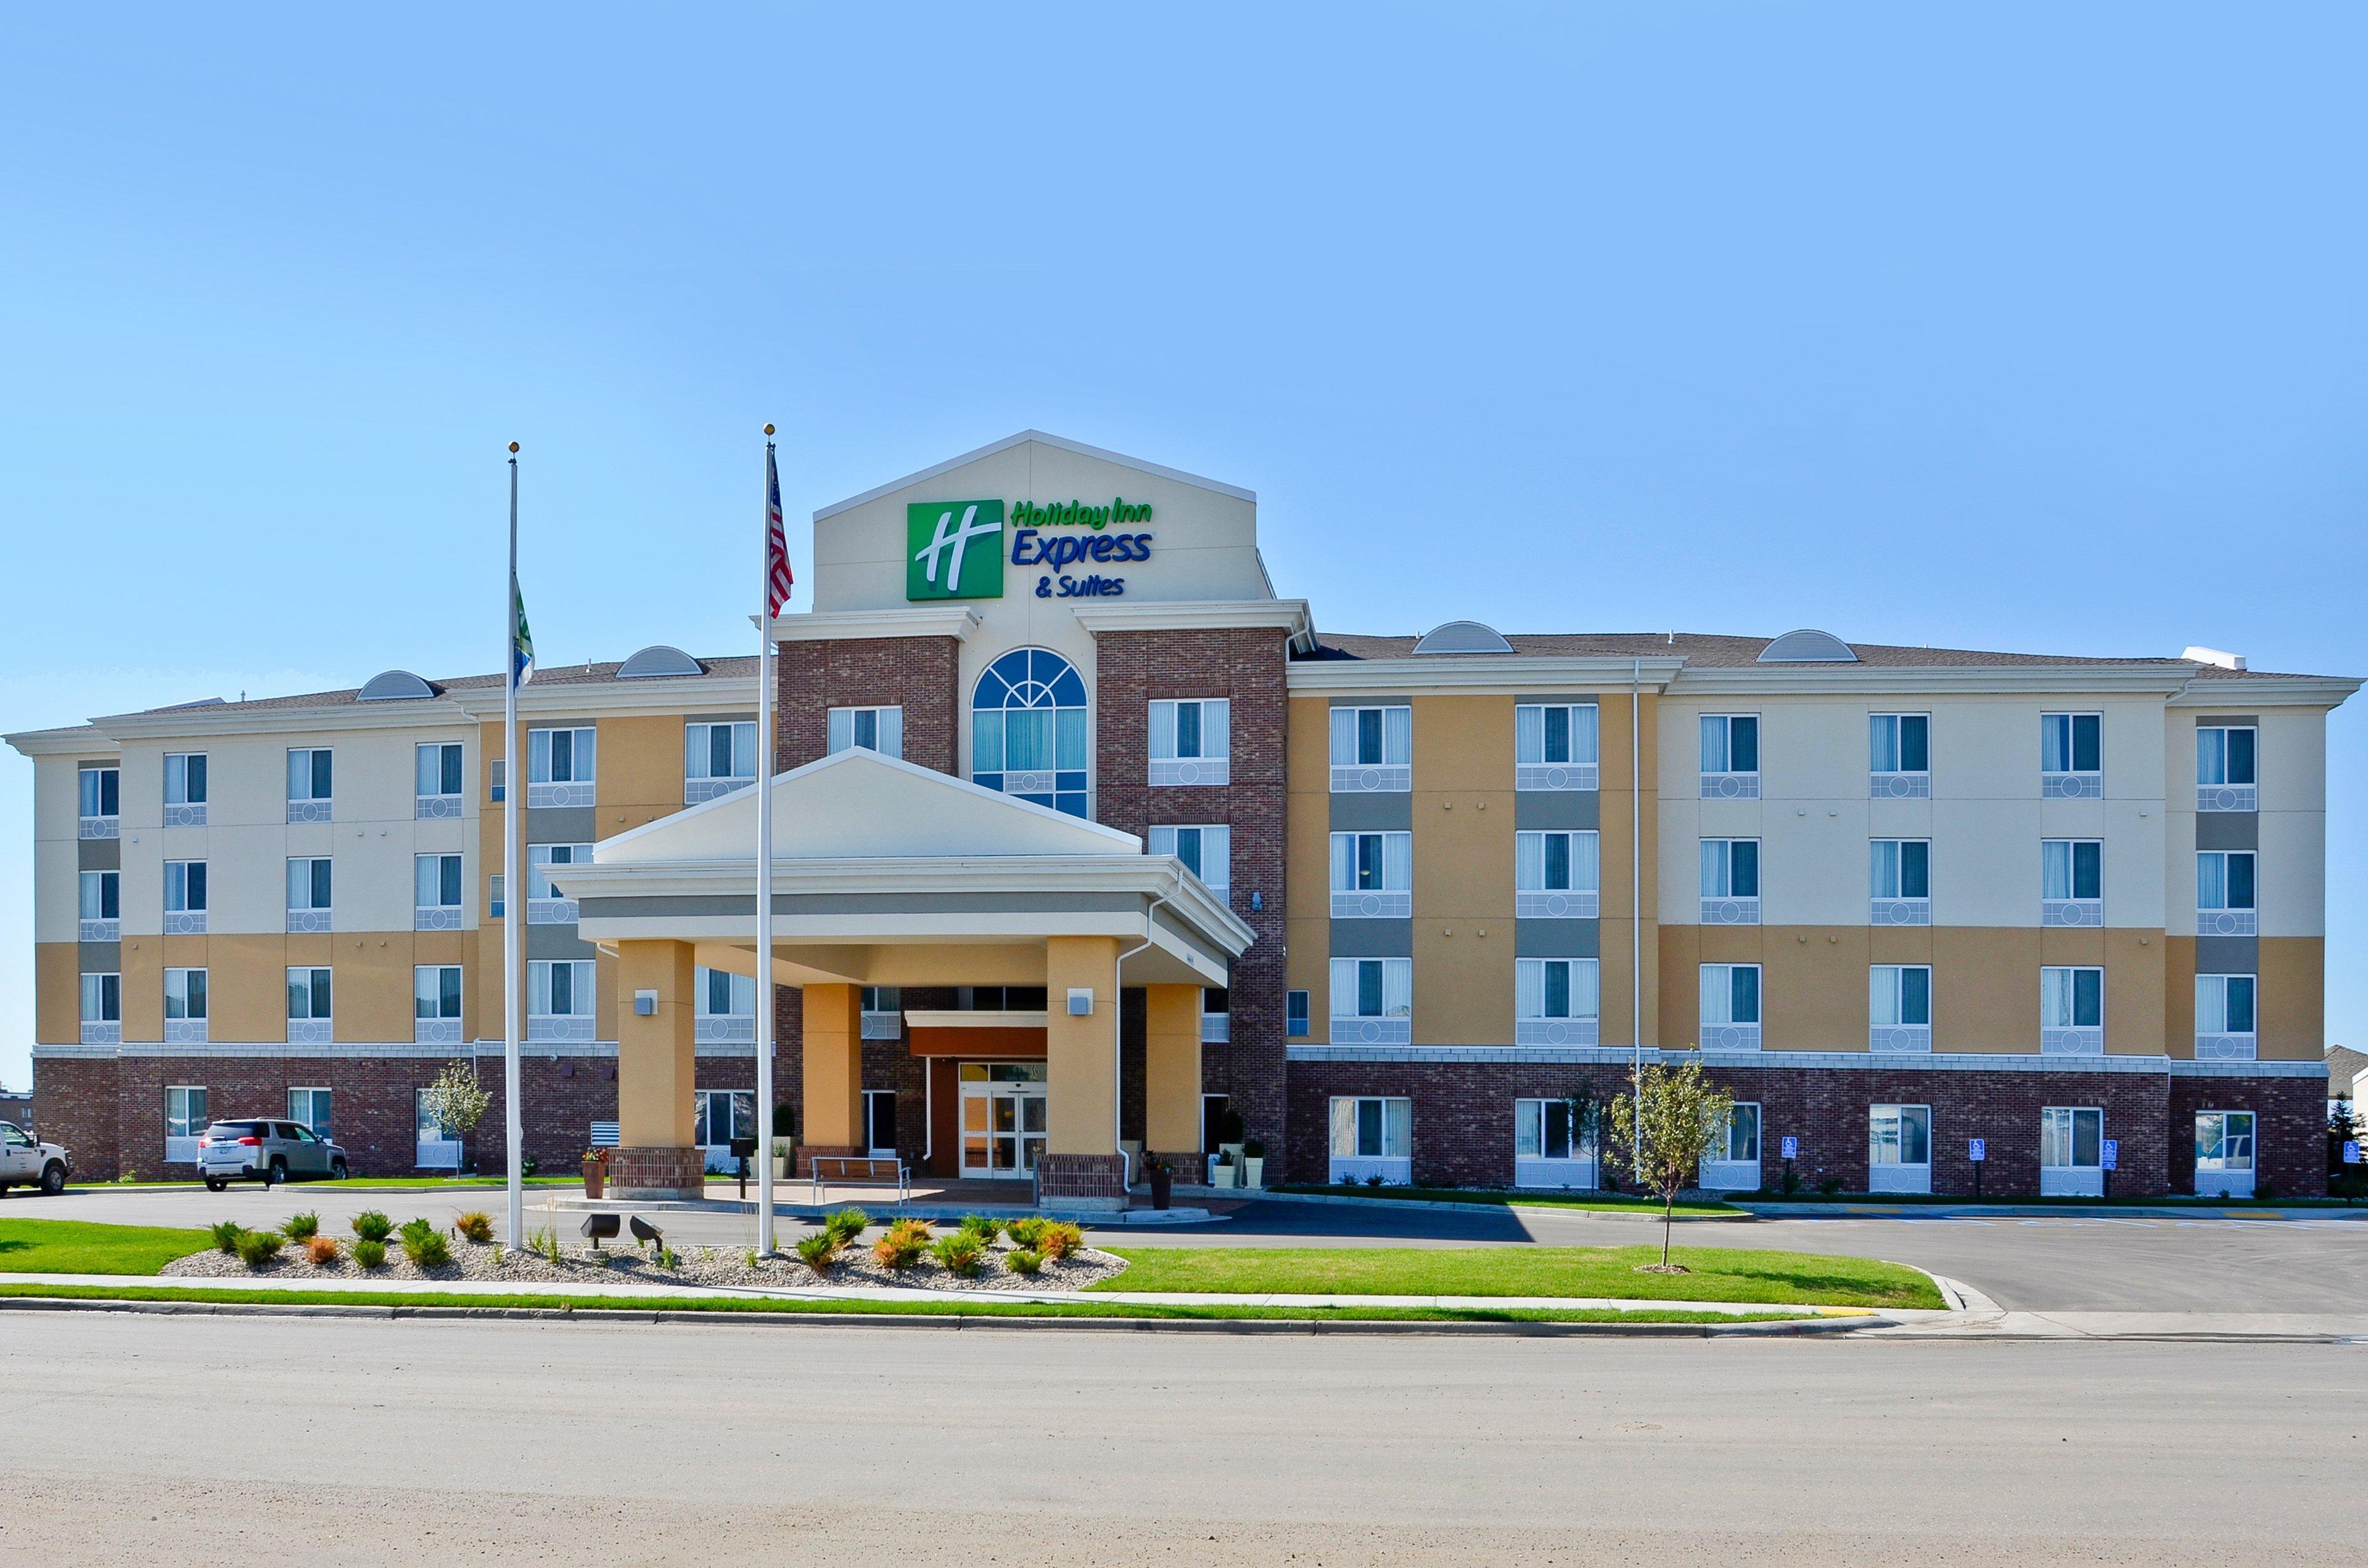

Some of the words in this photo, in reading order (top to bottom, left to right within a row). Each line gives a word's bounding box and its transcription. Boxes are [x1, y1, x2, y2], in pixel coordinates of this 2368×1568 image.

[1011, 499, 1108, 530] Holiday
[1111, 497, 1151, 522] Inn
[915, 505, 1001, 591] H
[1011, 530, 1152, 573] Express
[1035, 576, 1052, 598] &
[1056, 575, 1124, 597] Suites
